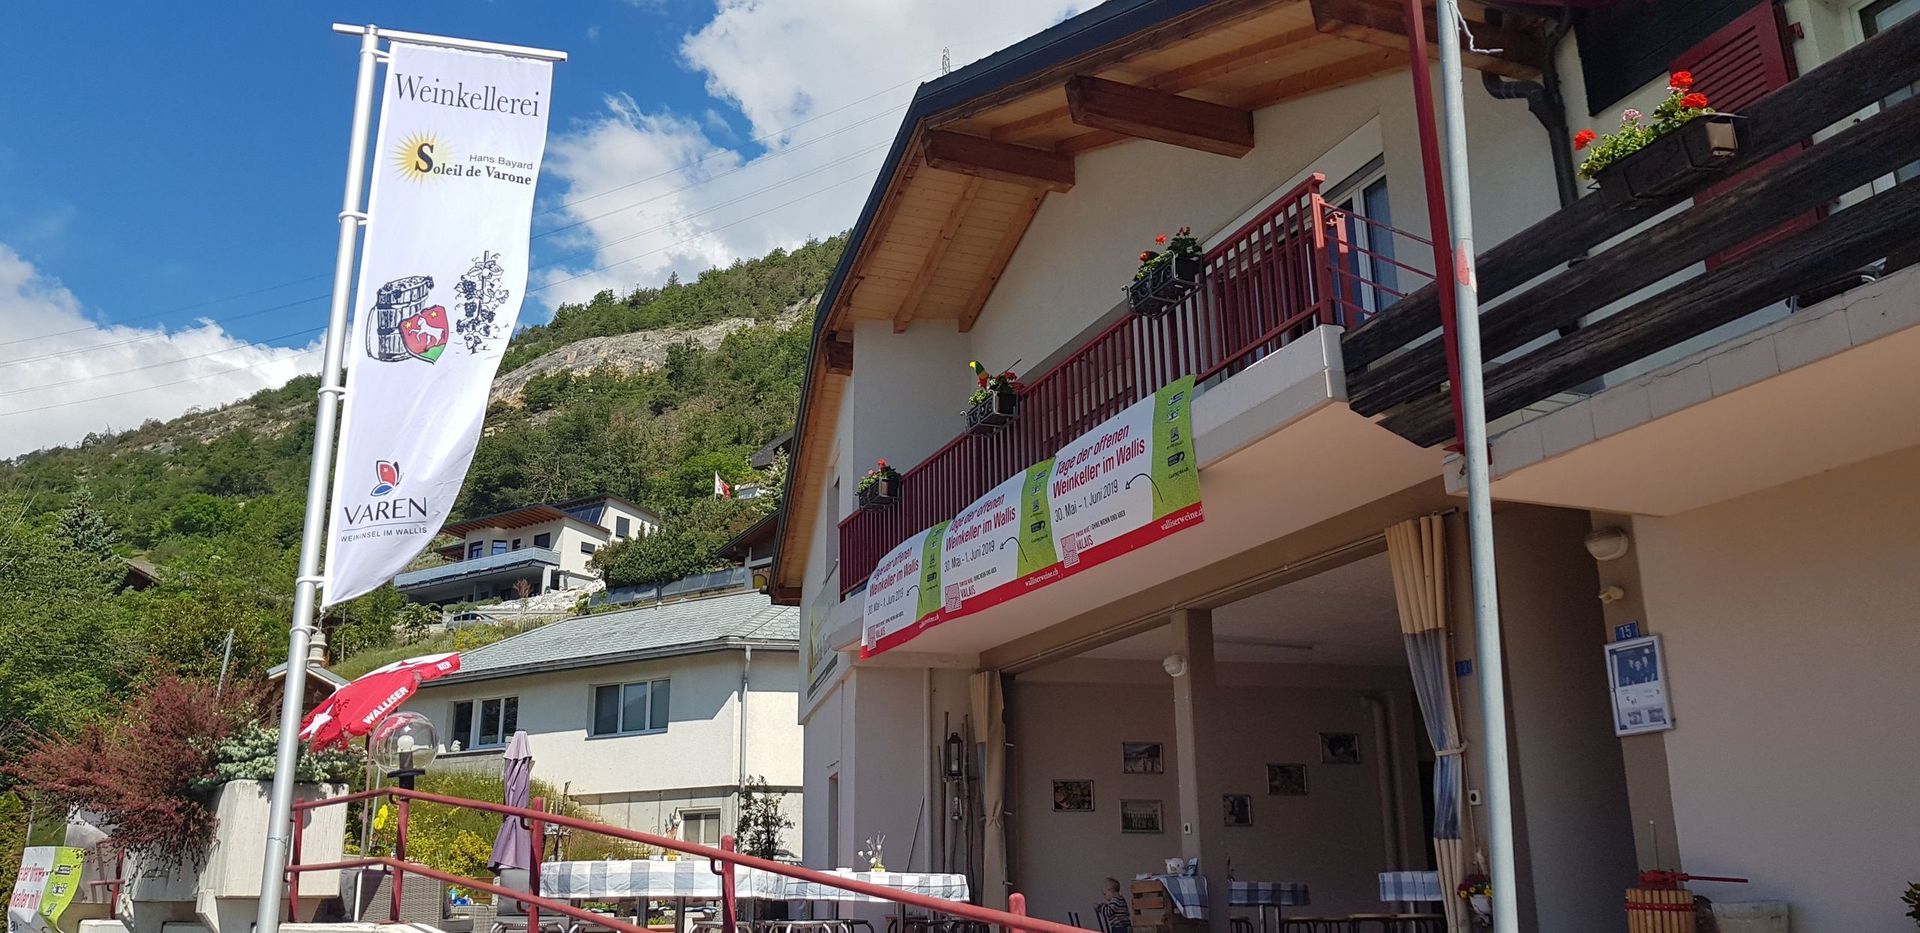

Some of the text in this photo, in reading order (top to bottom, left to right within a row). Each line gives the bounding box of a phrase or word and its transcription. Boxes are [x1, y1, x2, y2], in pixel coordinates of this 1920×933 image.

[394, 73, 540, 117] Weinkellerei
[415, 143, 532, 186] Soleil de Varone
[469, 154, 534, 170] Hans Bayard
[1053, 463, 1100, 499] Weinkeller
[1102, 455, 1115, 474] im
[1116, 437, 1145, 467] Wallis
[1056, 424, 1130, 477] Tage der offenen
[343, 496, 427, 526] VAREN
[983, 519, 992, 535] im
[994, 506, 1016, 529] Wallis
[1054, 507, 1065, 523] 30.
[1065, 500, 1077, 517] Mai
[1089, 488, 1103, 506] Juni
[1103, 480, 1118, 499] 2019
[340, 526, 428, 543] WEININSEL IM WALLIS
[1618, 624, 1632, 640] 15
[362, 686, 410, 726] WALLISER
